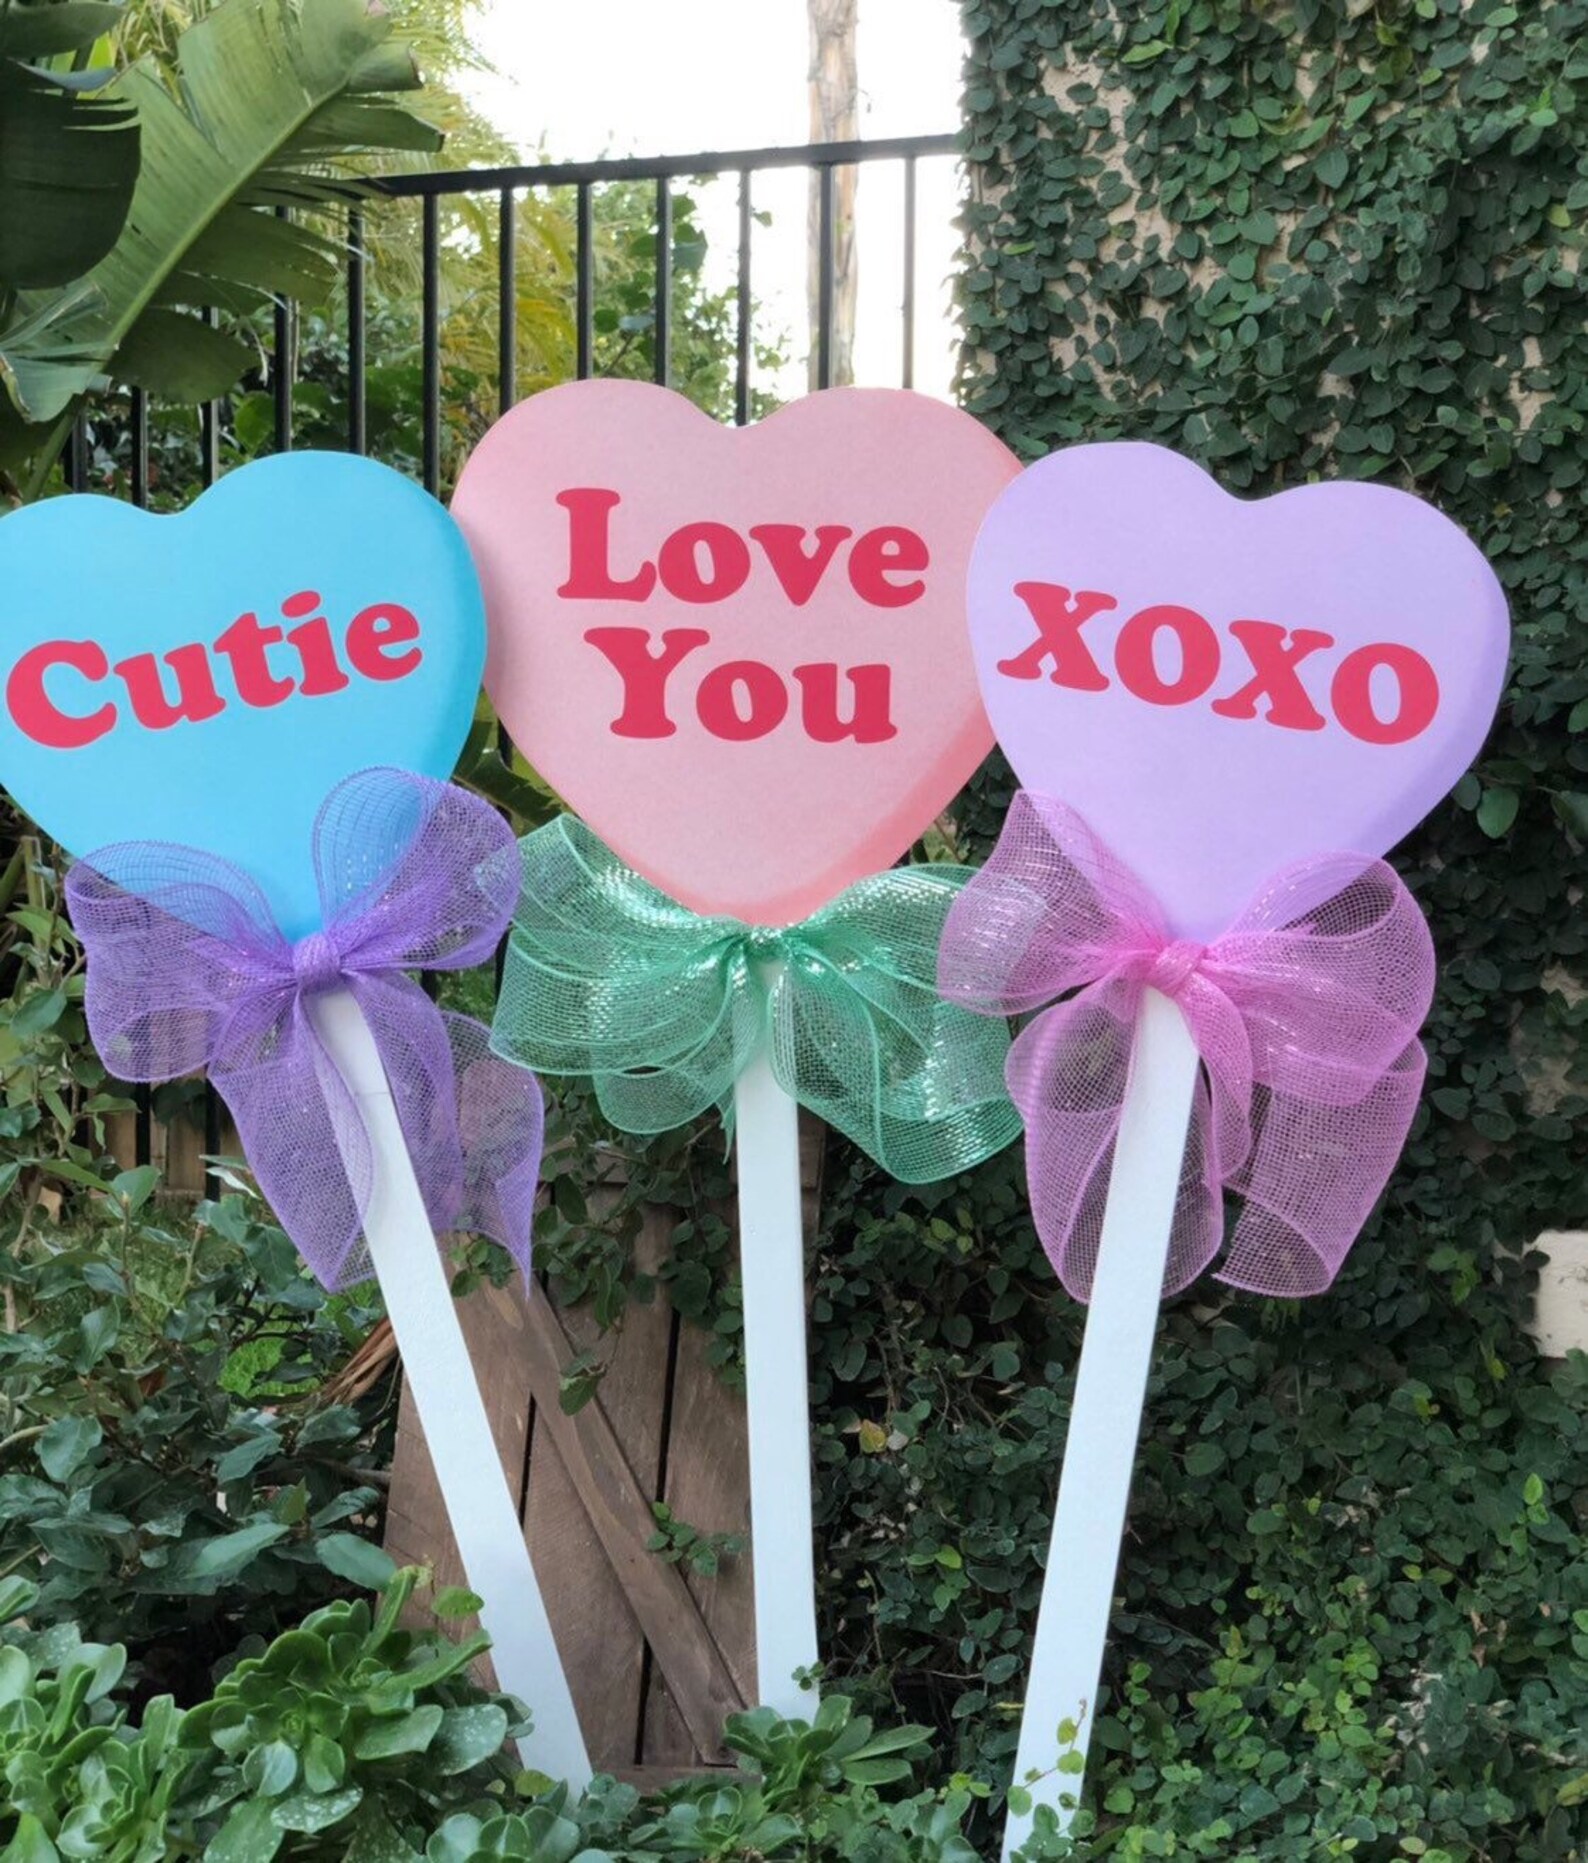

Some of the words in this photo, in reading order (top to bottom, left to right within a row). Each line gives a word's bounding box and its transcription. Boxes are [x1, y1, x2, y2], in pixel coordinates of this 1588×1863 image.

[556, 487, 929, 606] Love
[6, 590, 423, 749] Cutie
[584, 627, 898, 744] You
[998, 581, 1440, 745] XOXO
